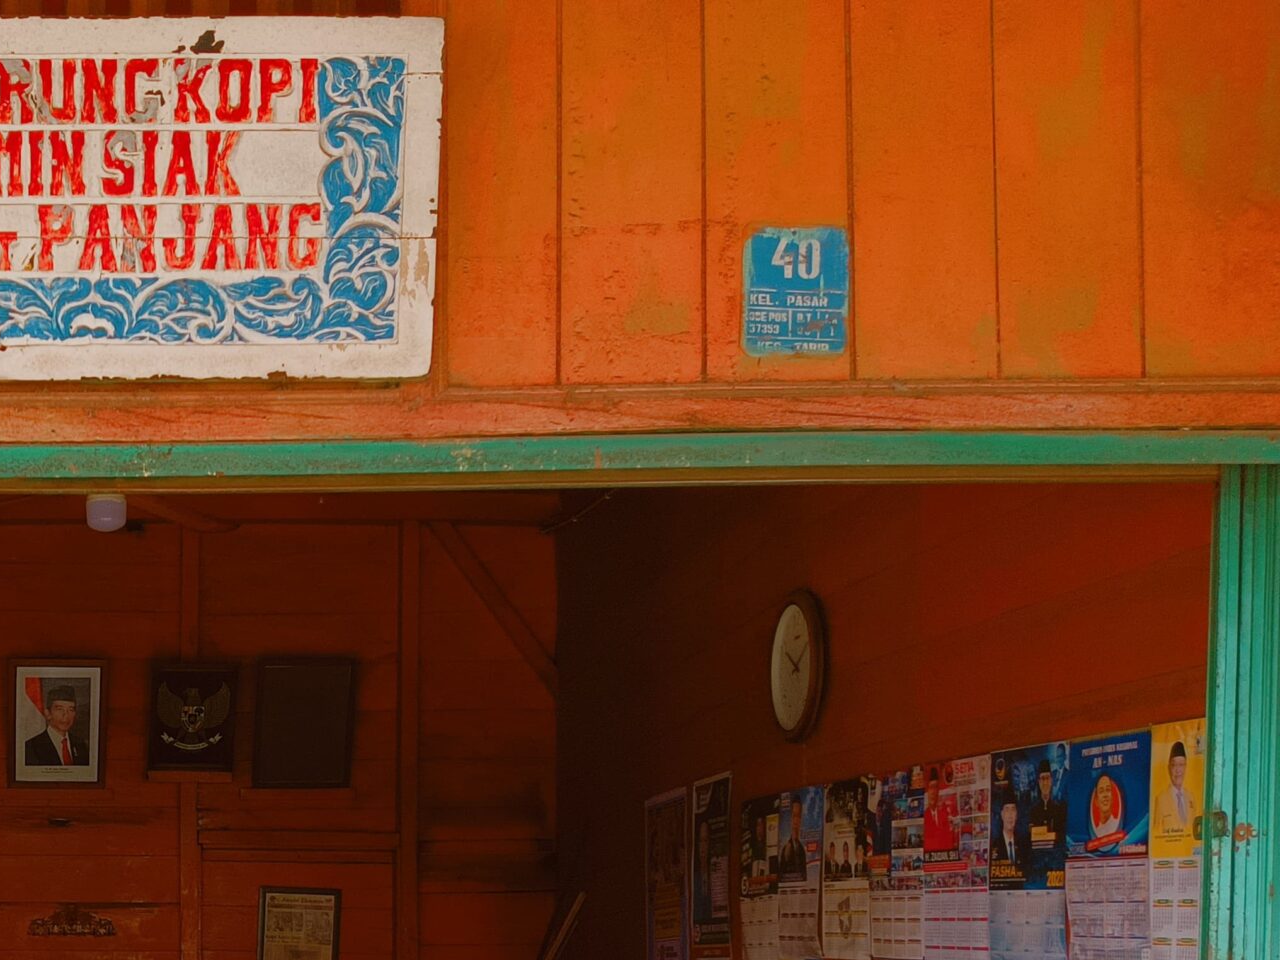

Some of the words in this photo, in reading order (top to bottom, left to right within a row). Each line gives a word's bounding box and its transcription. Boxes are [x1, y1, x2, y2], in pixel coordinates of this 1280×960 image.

[173, 57, 318, 124] KOPI
[101, 130, 241, 198] SIAK
[38, 203, 321, 273] PANJANG
[771, 238, 821, 280] 40
[787, 295, 828, 308] PASAR
[749, 323, 781, 335] 37353
